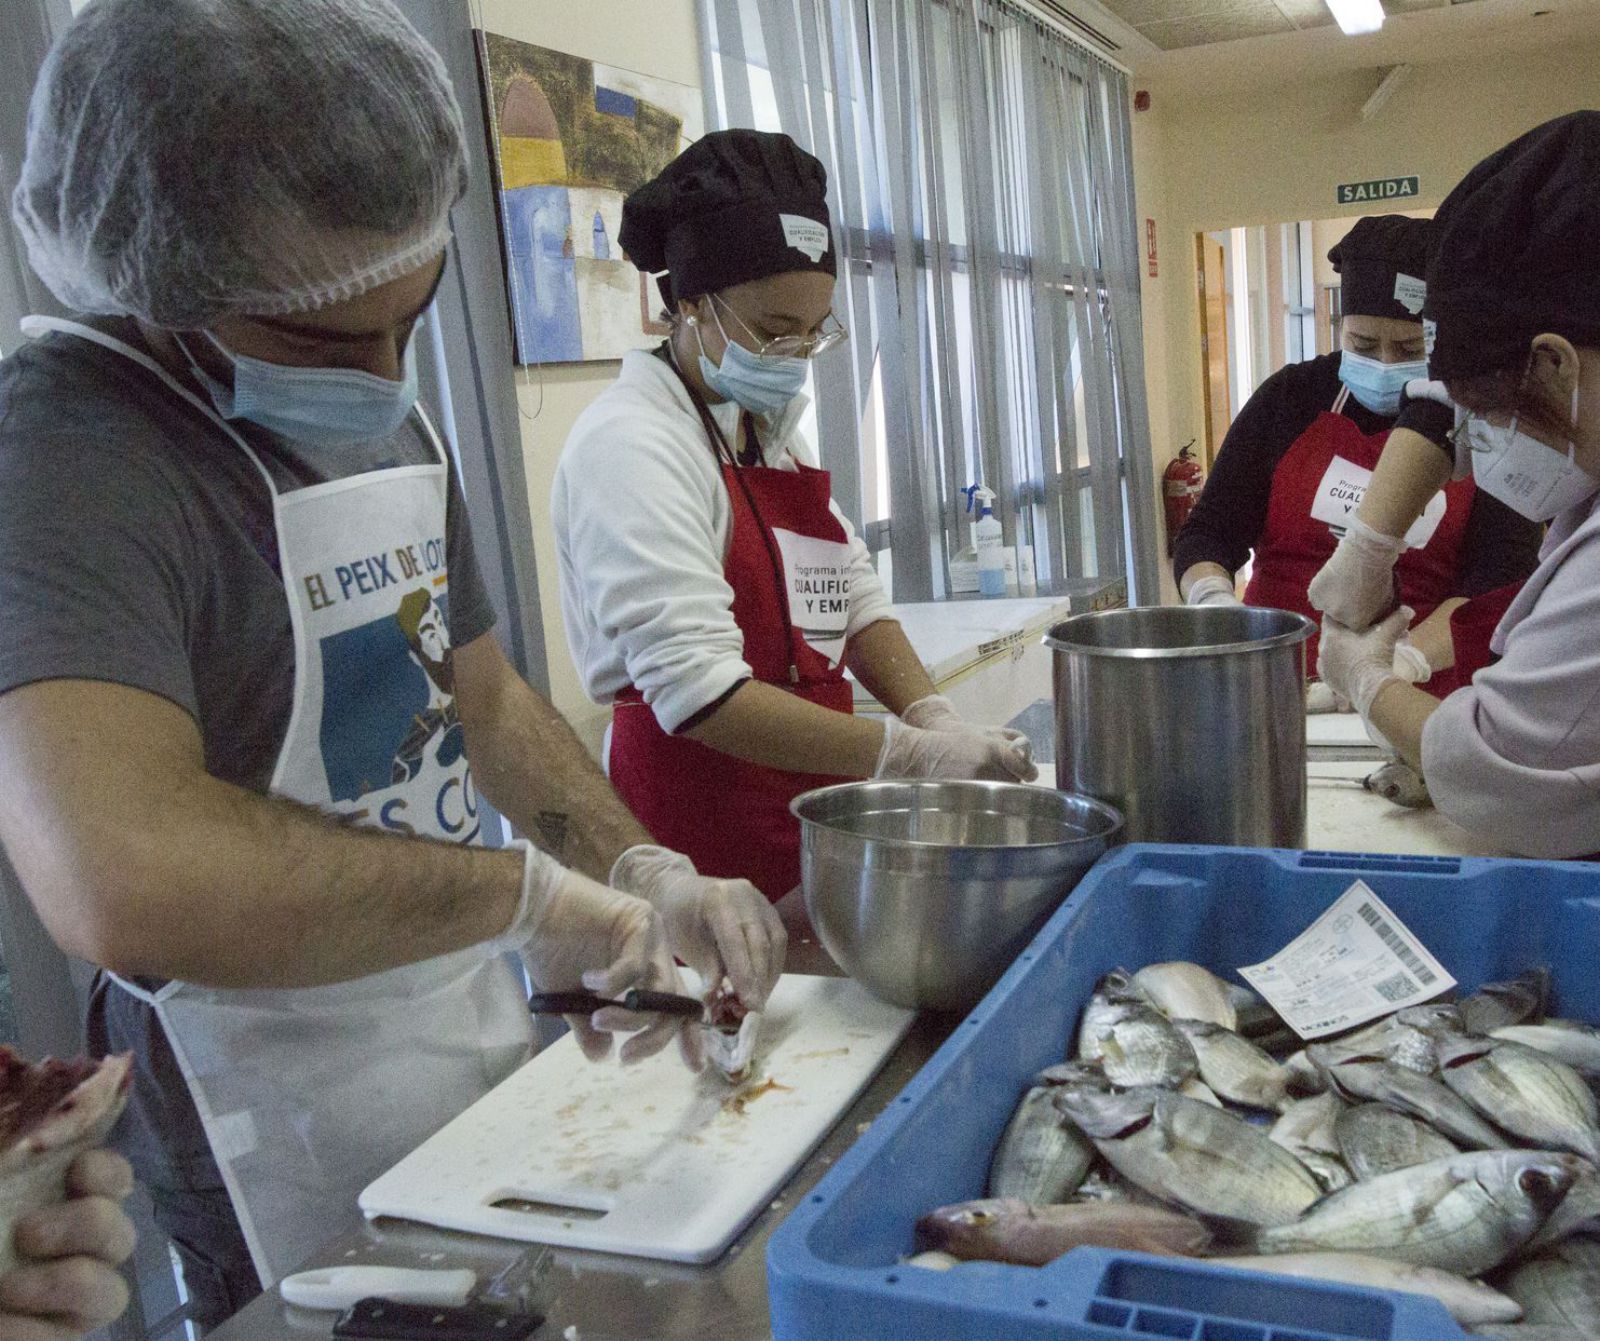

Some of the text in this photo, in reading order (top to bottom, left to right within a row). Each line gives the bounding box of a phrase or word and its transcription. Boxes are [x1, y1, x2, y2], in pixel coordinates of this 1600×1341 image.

[1343, 179, 1412, 201] SALIDA
[303, 573, 335, 611] EL
[335, 553, 398, 600] PEIX
[395, 545, 423, 581] DE
[805, 600, 814, 614] Y
